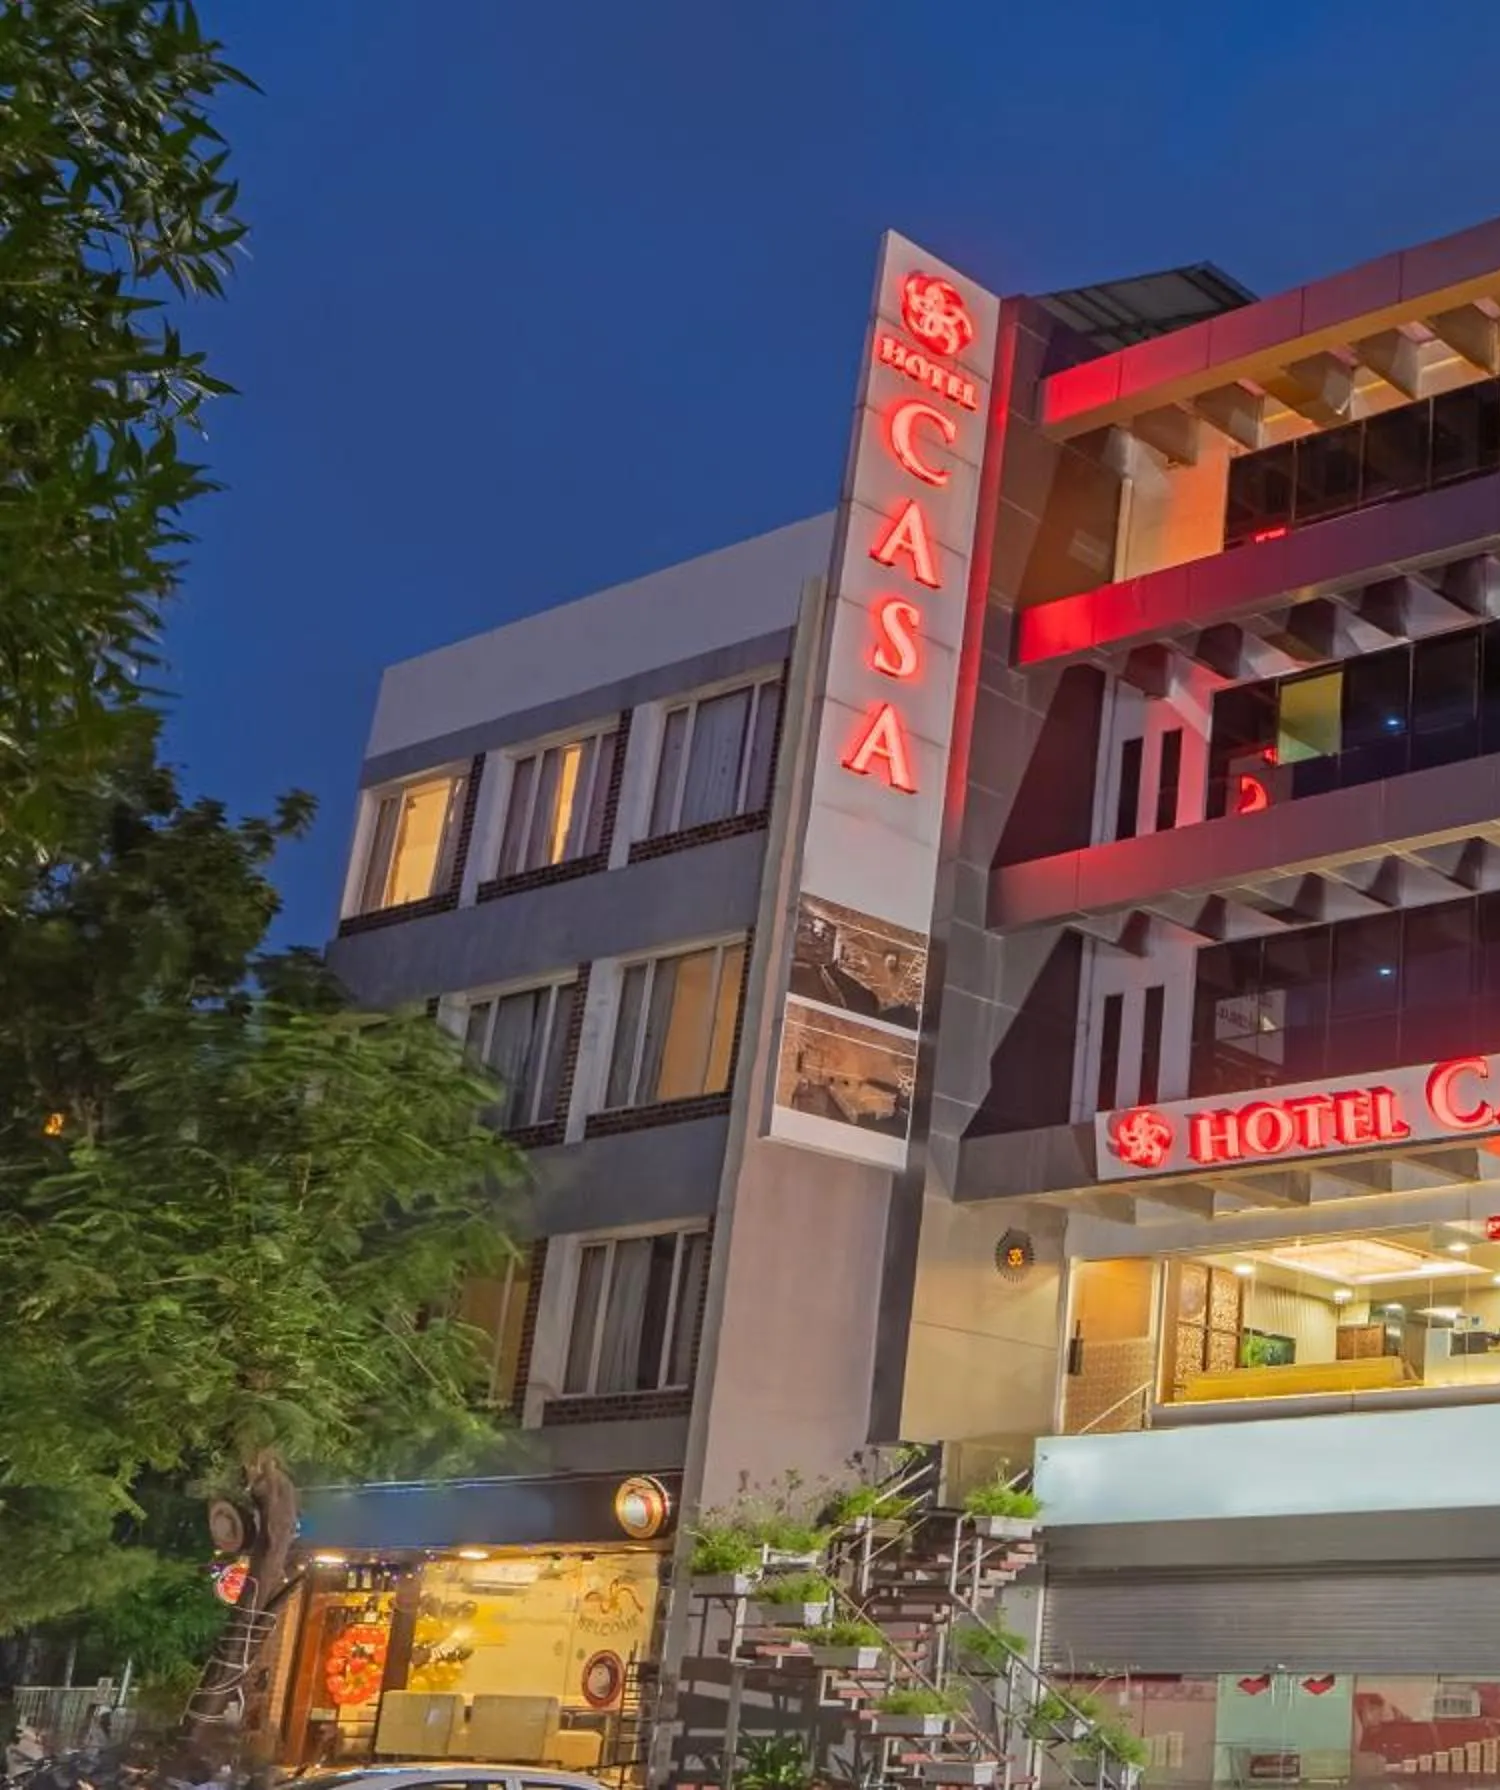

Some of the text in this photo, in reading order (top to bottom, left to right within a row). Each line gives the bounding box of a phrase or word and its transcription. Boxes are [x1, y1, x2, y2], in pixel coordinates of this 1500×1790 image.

[878, 336, 978, 411] HOTEL
[841, 401, 957, 795] CASA
[1188, 1086, 1411, 1163] HOTEL
